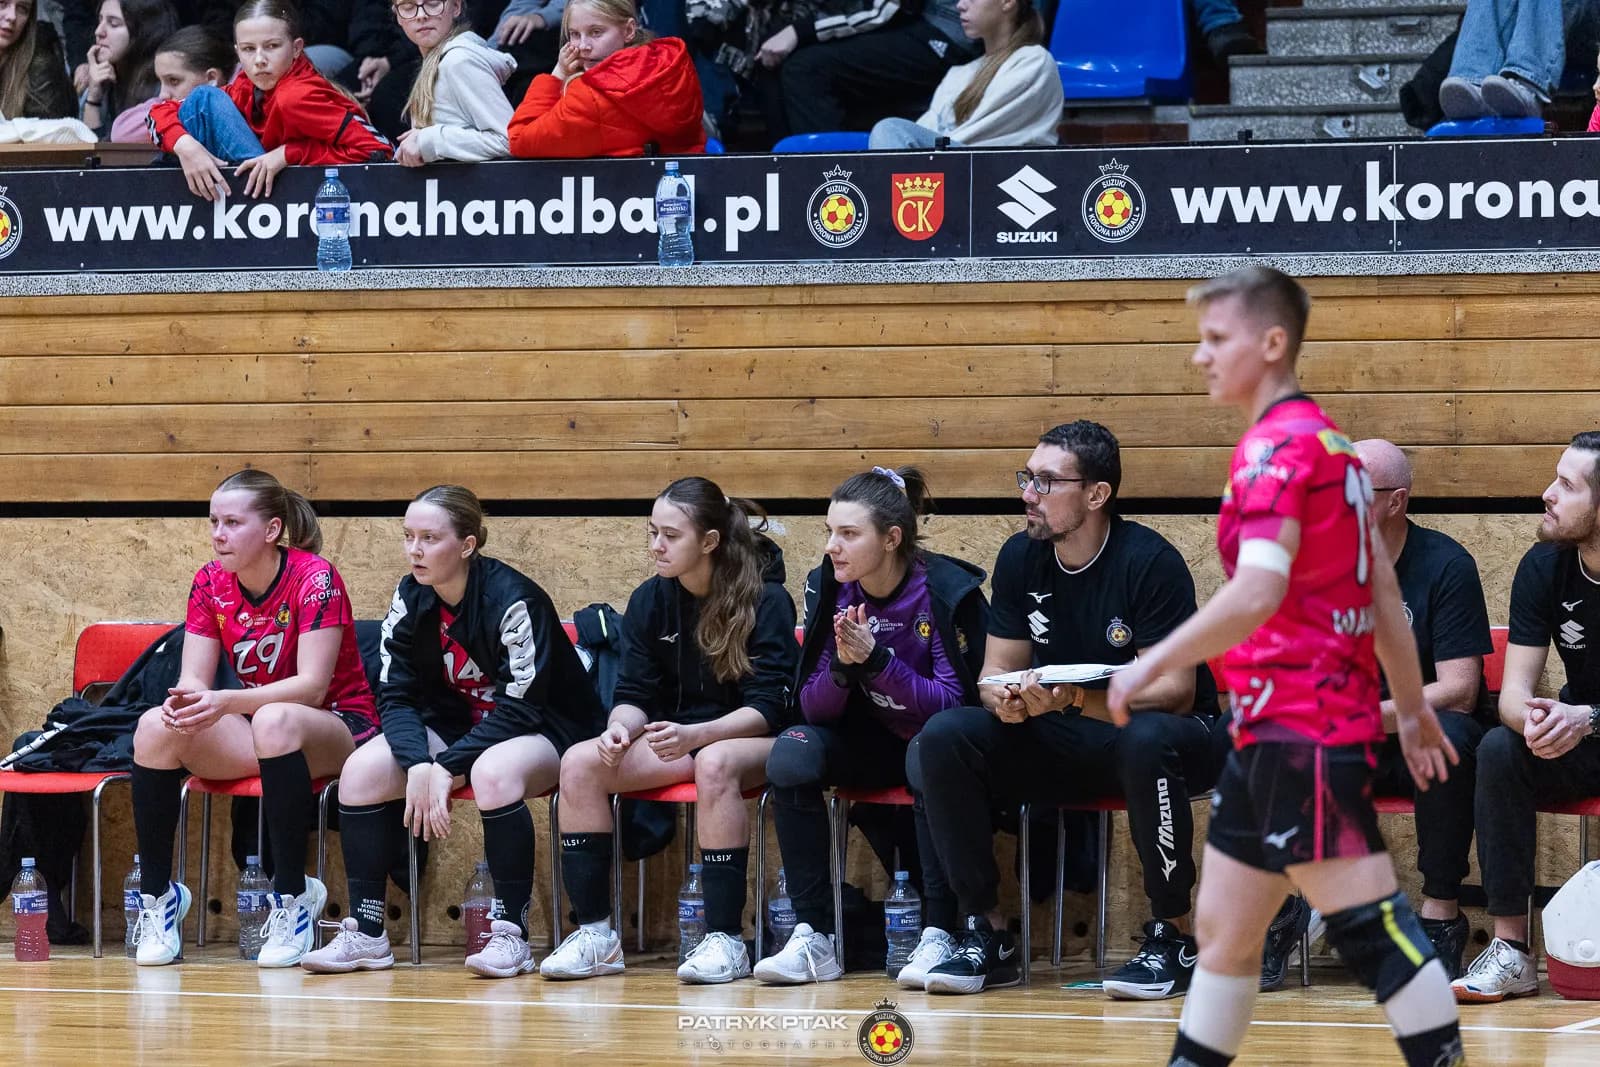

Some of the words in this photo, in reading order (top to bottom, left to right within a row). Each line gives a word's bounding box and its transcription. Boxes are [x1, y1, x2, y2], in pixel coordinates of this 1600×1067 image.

[825, 184, 850, 195] SUZUKI
[1101, 178, 1127, 188] SUZUKI
[43, 172, 780, 252] www.kornahandba.pl
[897, 199, 934, 233] CK
[1088, 213, 1111, 237] KORONA
[1111, 212, 1141, 237] HANDBALL
[812, 218, 835, 242] KORONA
[996, 231, 1058, 243] SUZUKI
[233, 631, 285, 674] 29
[443, 652, 484, 684] 14
[1156, 777, 1175, 850] MIZUNO
